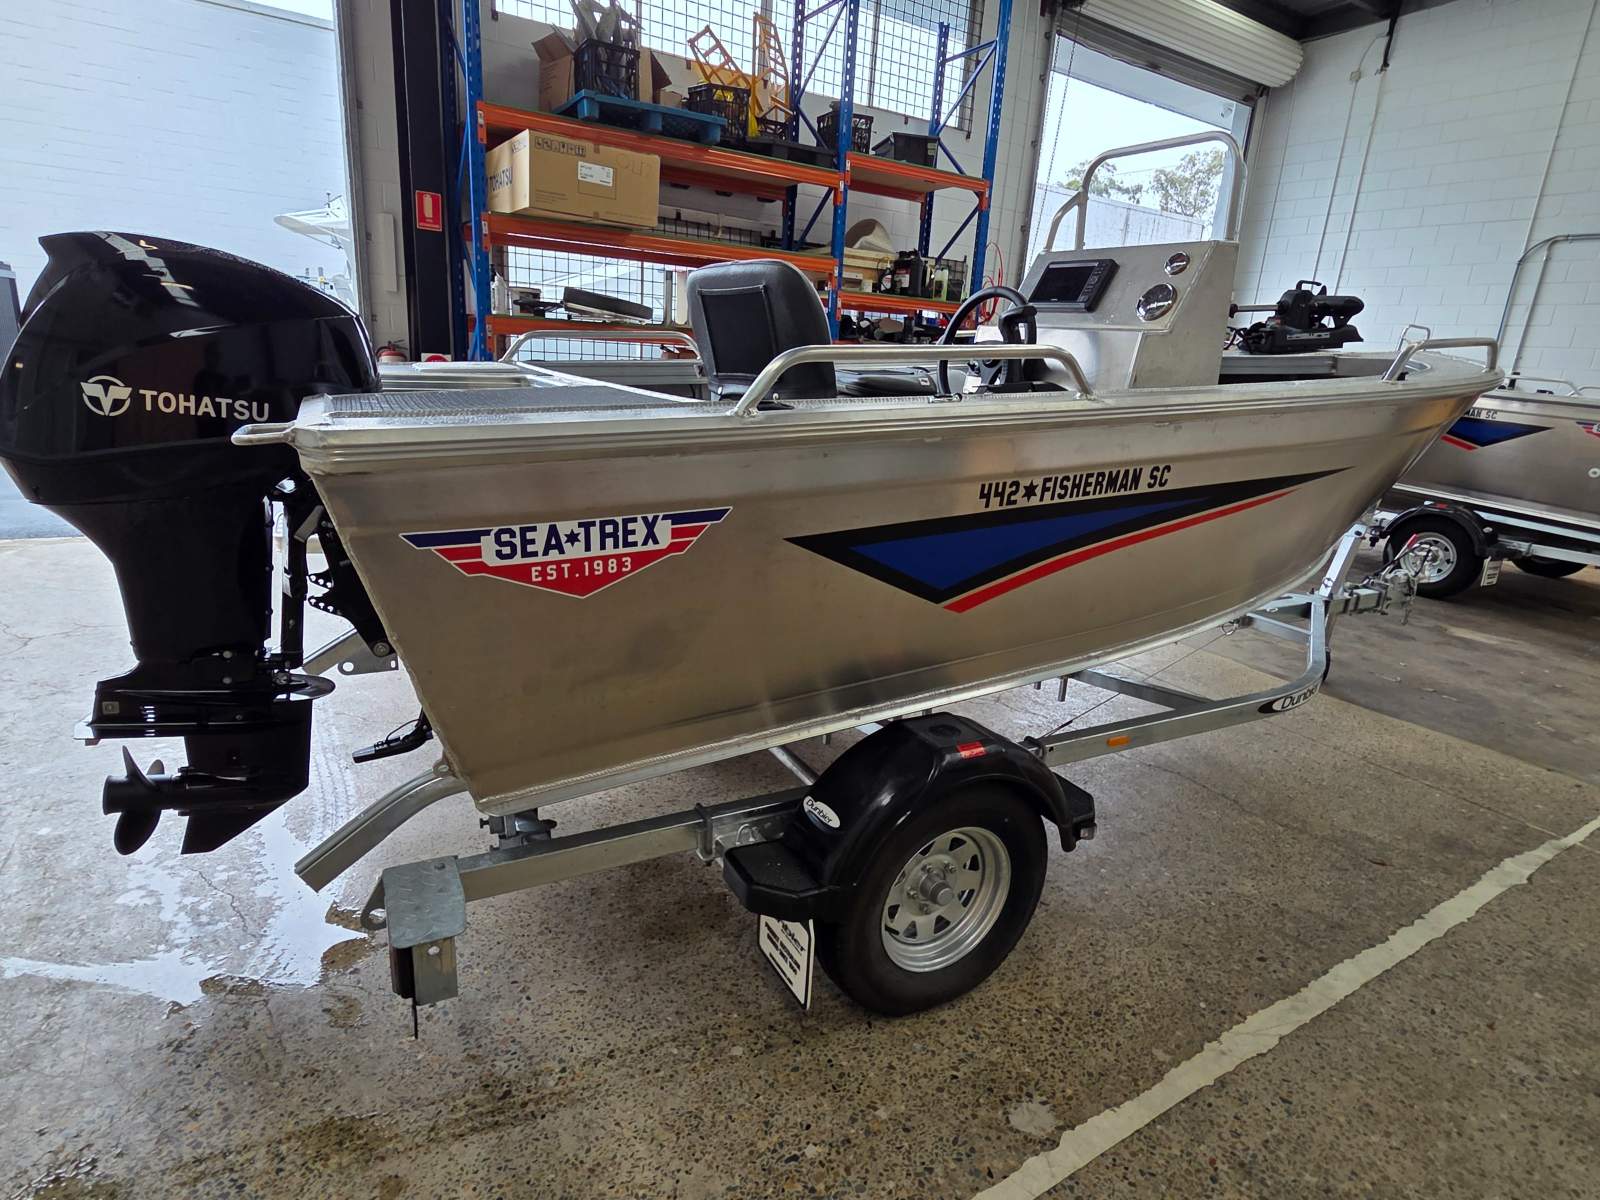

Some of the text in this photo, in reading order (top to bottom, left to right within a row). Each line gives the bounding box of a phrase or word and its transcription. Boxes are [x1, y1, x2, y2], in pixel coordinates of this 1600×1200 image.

[138, 389, 270, 422] TOHATSU
[979, 465, 1172, 508] 442 FISHERMAN SC
[493, 514, 661, 561] SEA TREX
[806, 799, 833, 824] Dunbier
